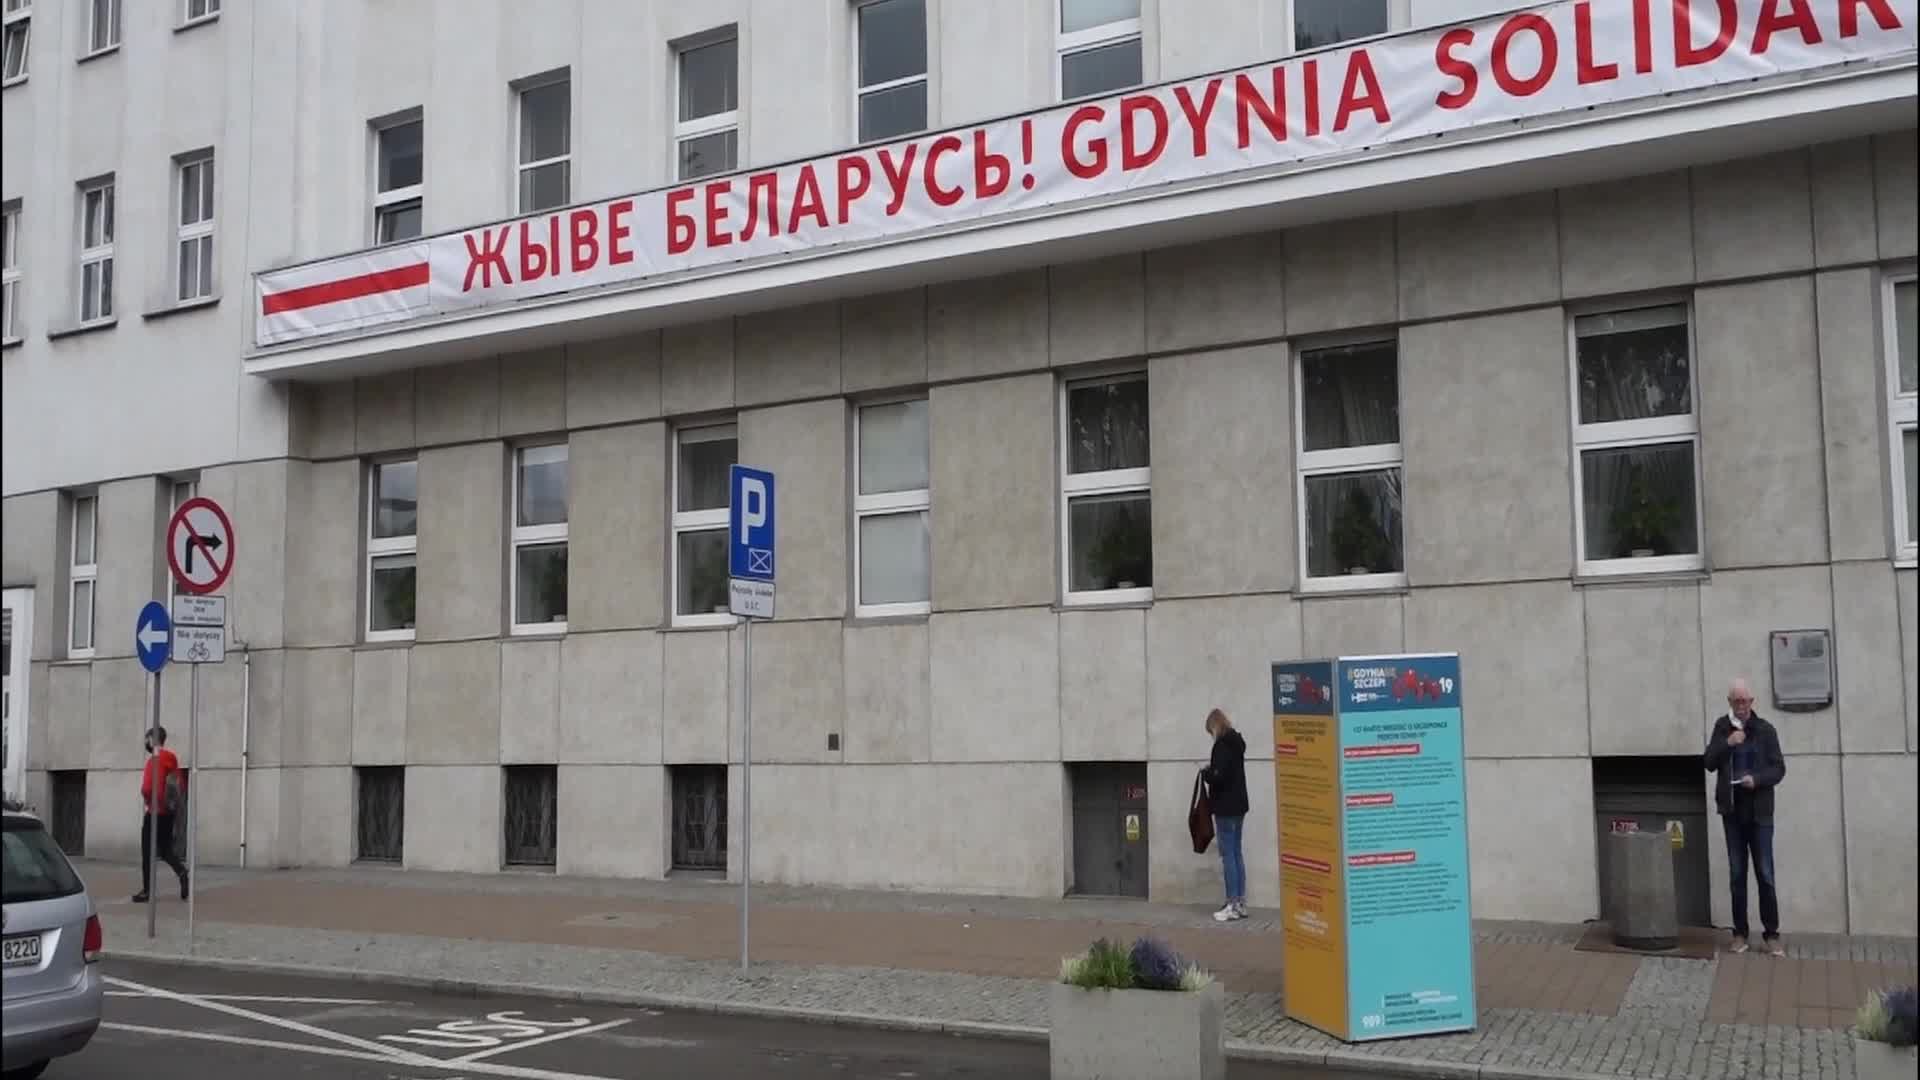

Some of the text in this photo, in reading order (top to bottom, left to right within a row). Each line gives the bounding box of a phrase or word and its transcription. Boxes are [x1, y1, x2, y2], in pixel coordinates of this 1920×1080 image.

[1062, 49, 1391, 179] GDYNIA
[465, 120, 1034, 290] ЖЫВЕ БЕЛАРУСЬ!
[741, 476, 767, 545] P
[1438, 676, 1454, 694] 19
[4, 938, 39, 960] 8220
[377, 1010, 592, 1048] USC
